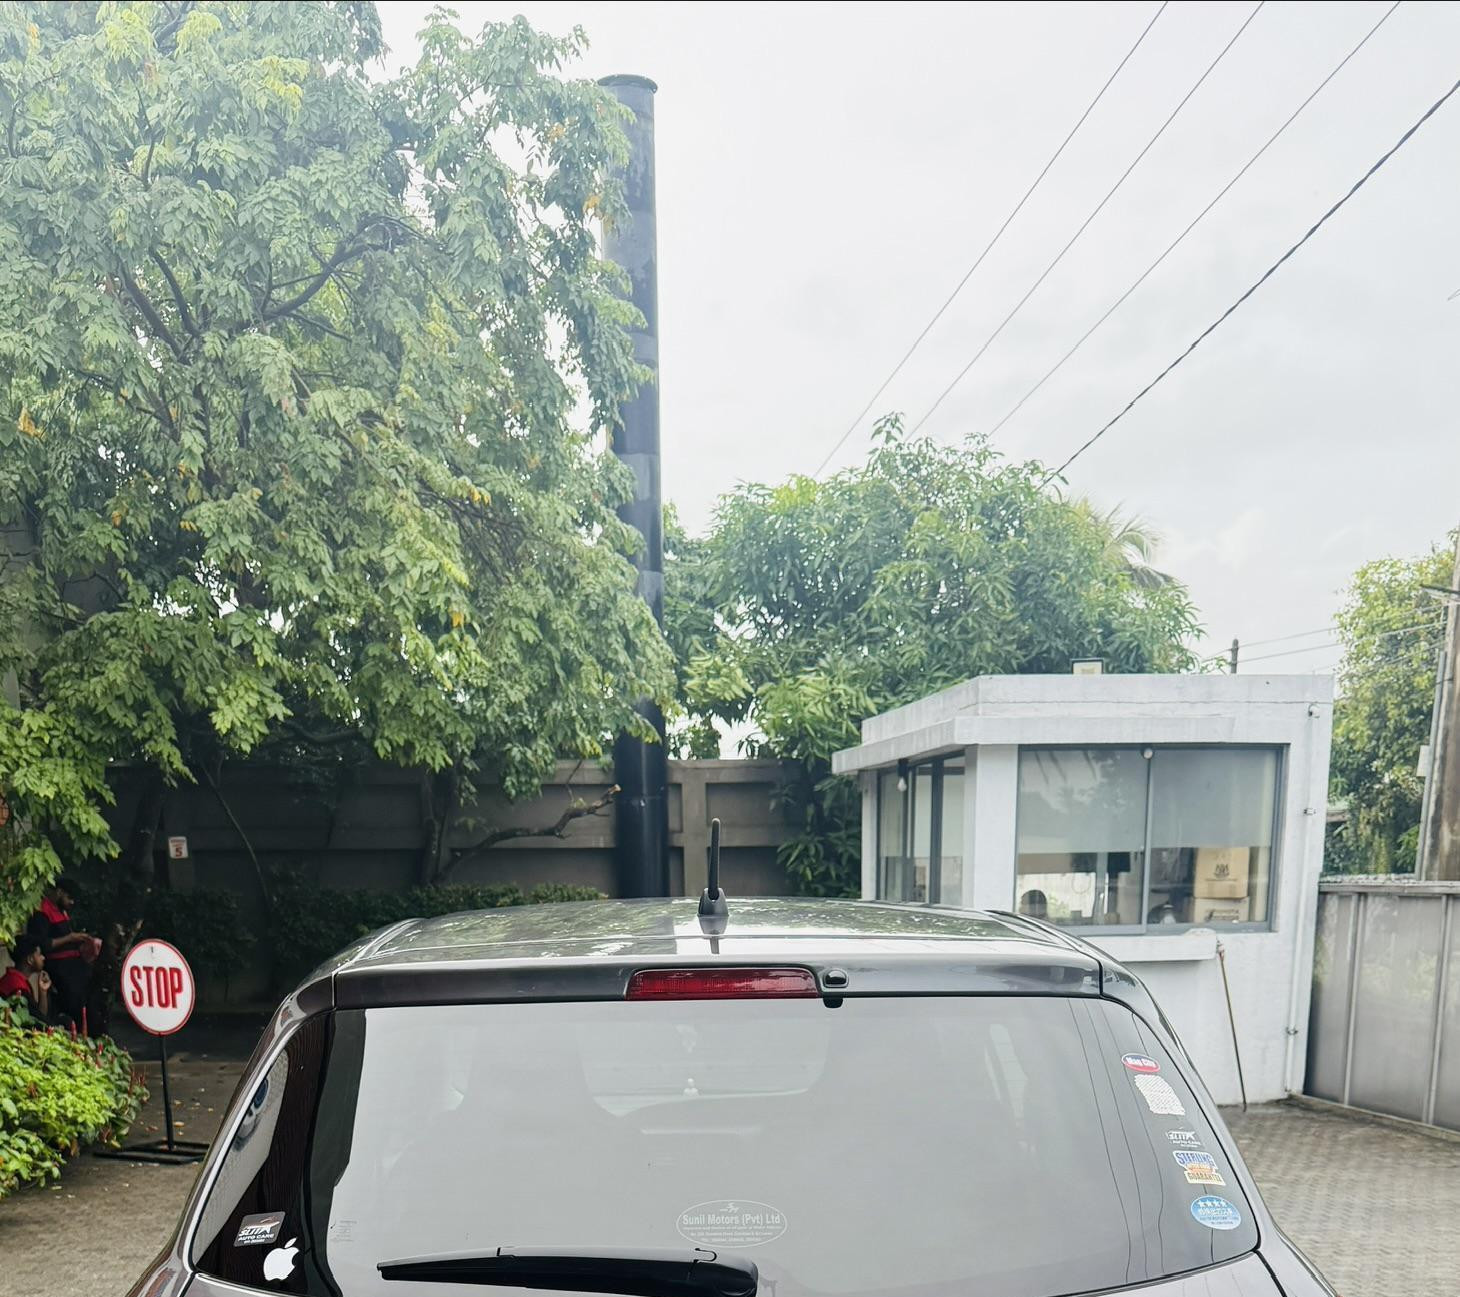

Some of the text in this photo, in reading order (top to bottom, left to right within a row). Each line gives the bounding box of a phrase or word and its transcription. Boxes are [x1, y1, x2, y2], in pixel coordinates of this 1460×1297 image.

[129, 965, 184, 1009] STOP
[1175, 1152, 1216, 1167] STERLING
[682, 1213, 781, 1227] Sunil Motors (Pvt) Ltd
